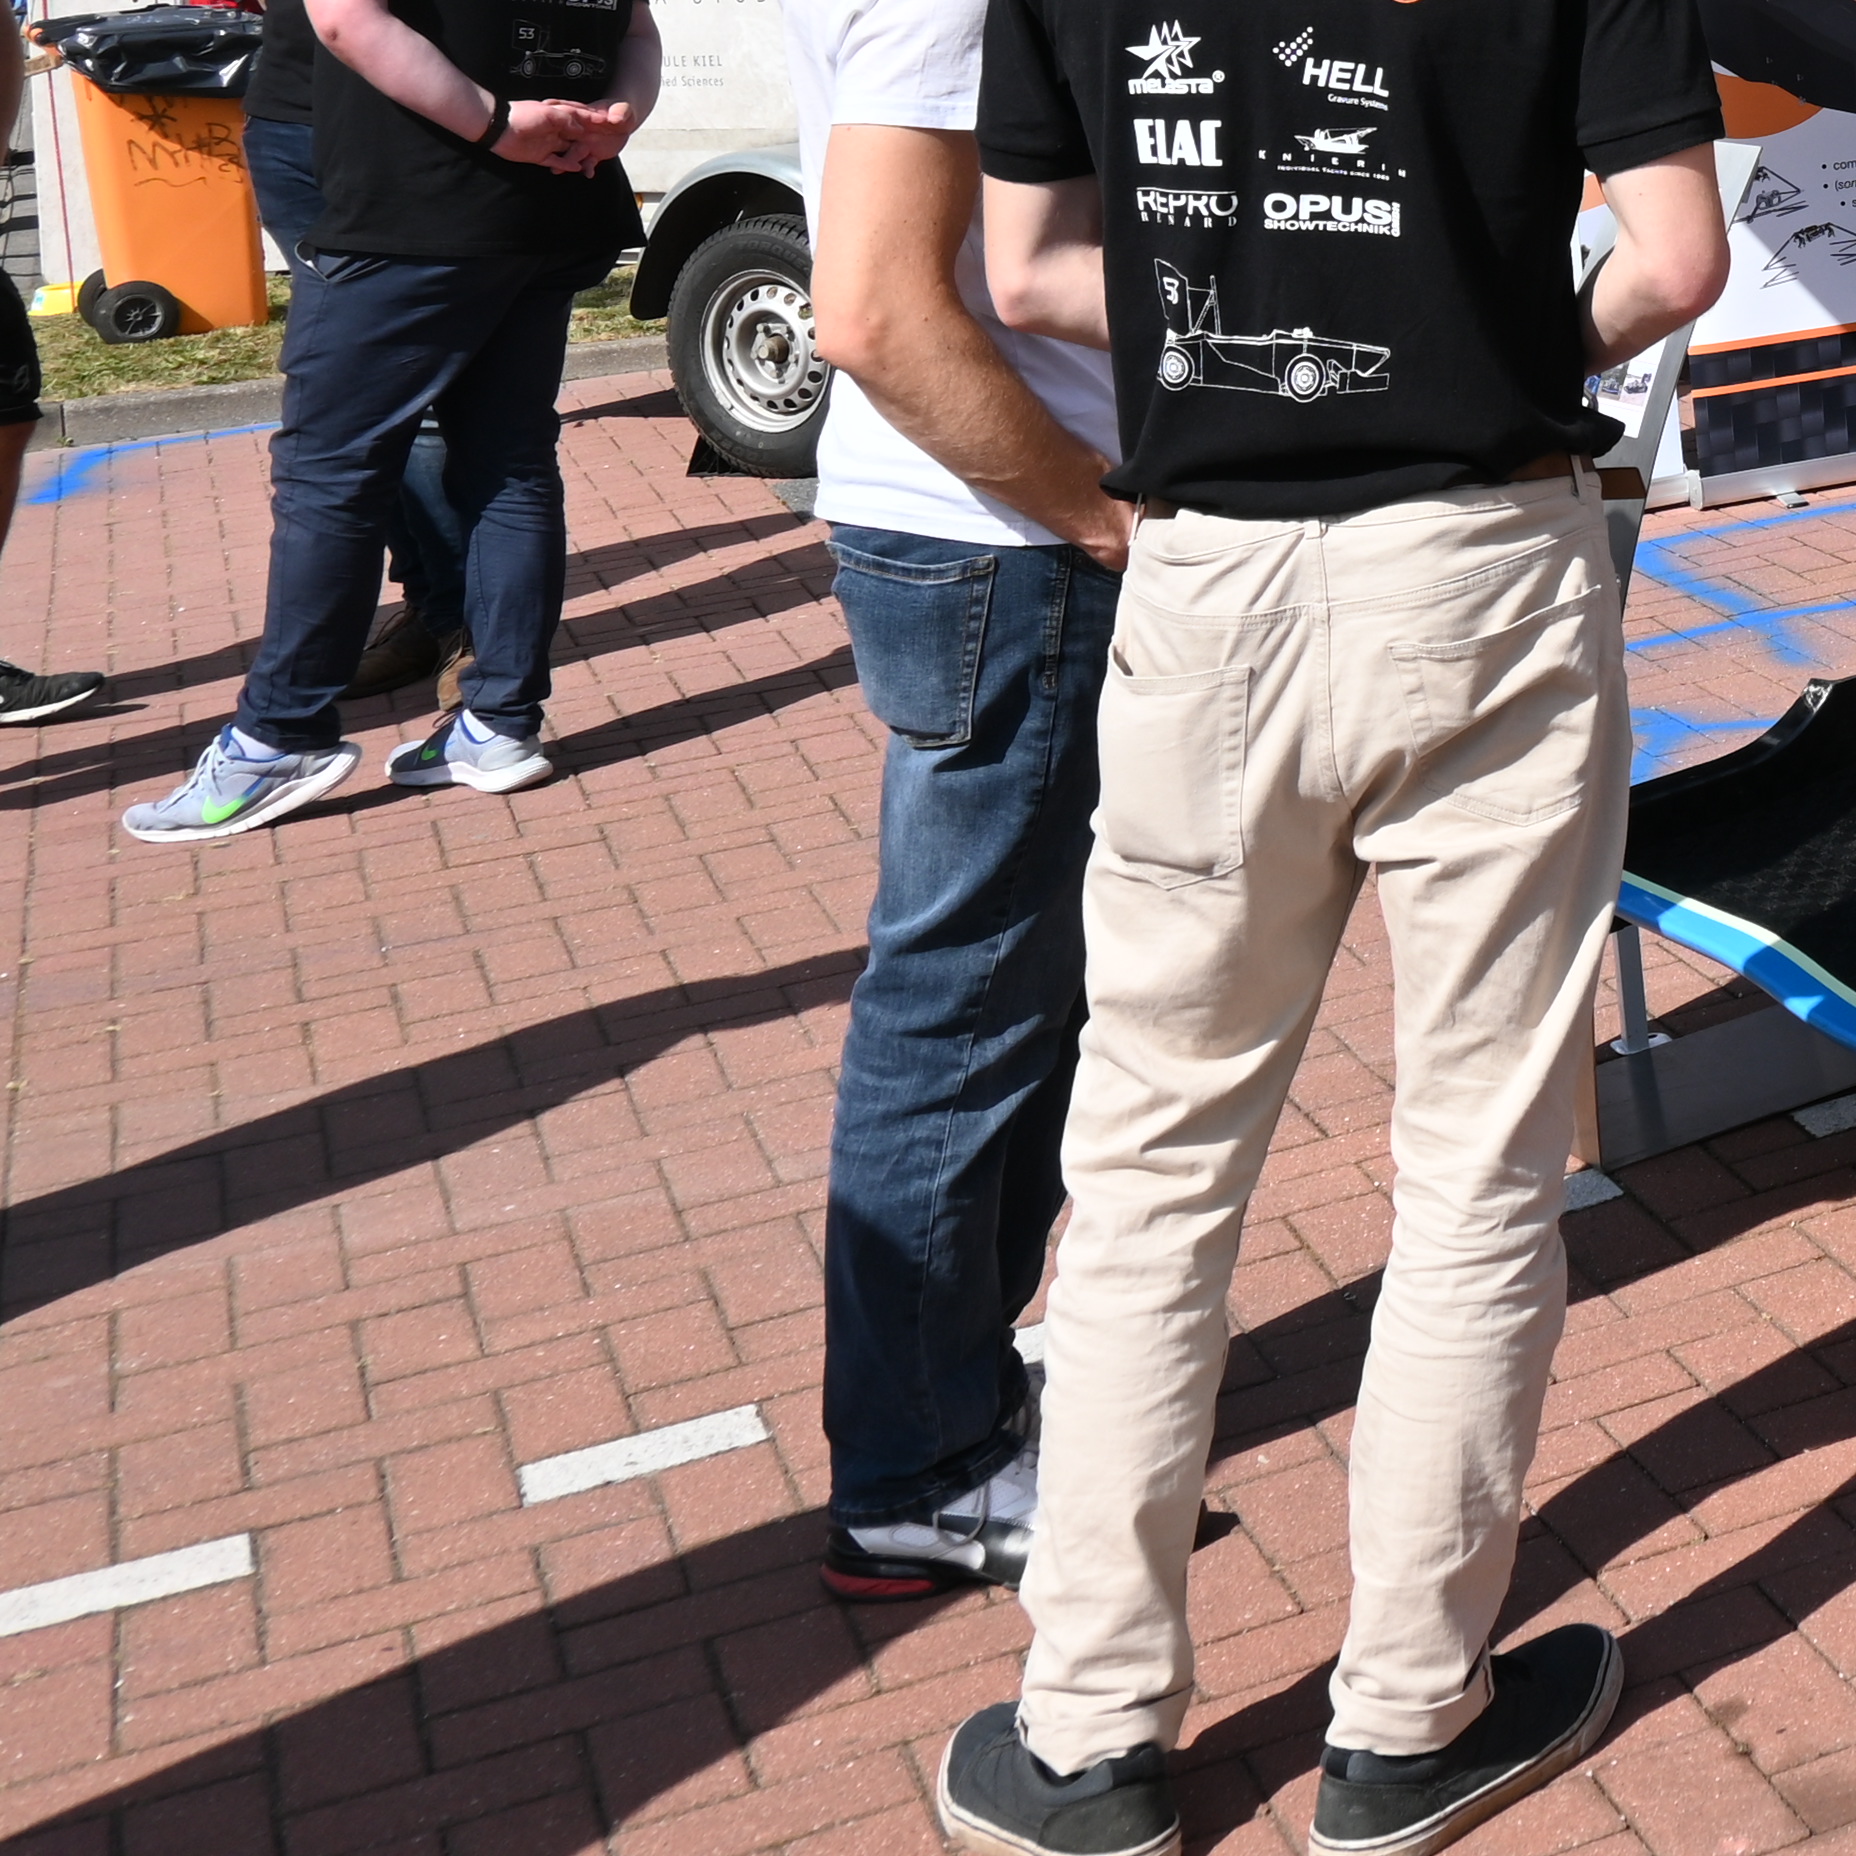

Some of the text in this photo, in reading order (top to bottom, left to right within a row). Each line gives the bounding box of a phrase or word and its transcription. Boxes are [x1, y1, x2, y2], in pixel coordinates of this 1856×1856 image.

[519, 27, 535, 39] 53
[694, 55, 723, 67] KIEL
[1302, 57, 1389, 97] HELL
[1328, 94, 1359, 105] Gravure
[1133, 118, 1223, 166] ELAC
[1136, 190, 1238, 216] REPRO
[1263, 192, 1391, 225] OPUS
[1141, 211, 1237, 228] RENARD
[1264, 219, 1391, 235] SHOWTECHNIK
